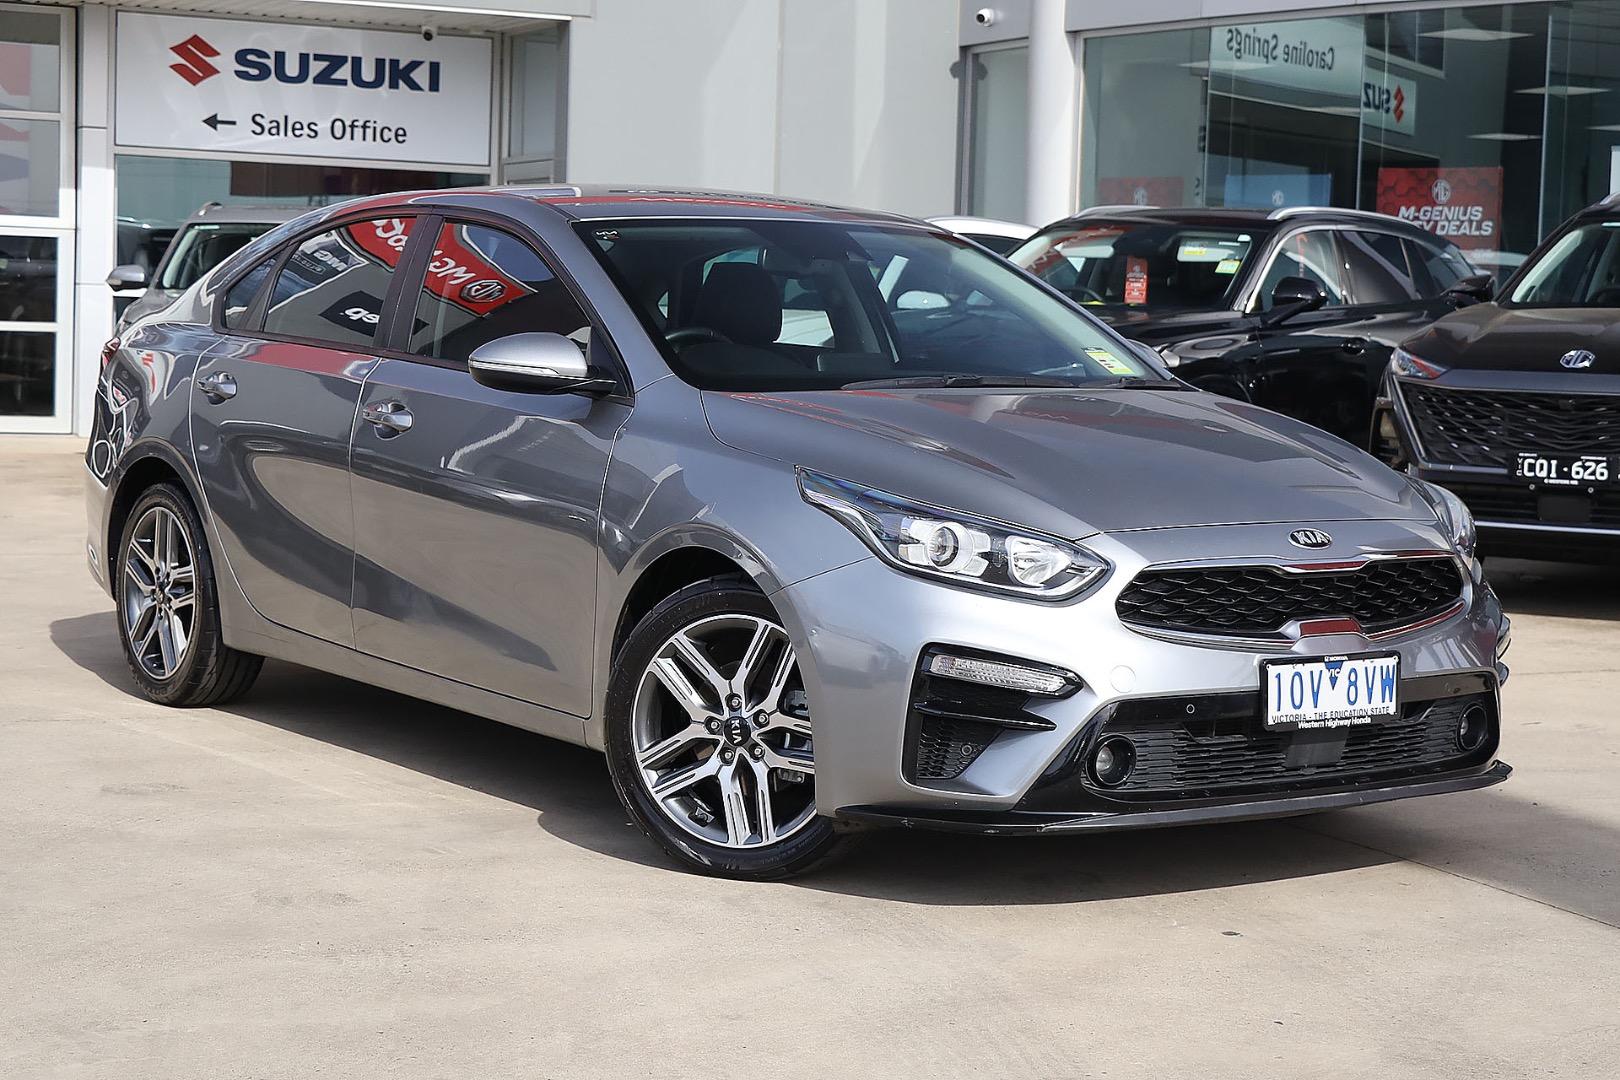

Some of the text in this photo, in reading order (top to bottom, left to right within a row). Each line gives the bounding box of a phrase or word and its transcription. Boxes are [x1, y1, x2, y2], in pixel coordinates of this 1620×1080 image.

[233, 47, 440, 93] SUZUKI
[250, 114, 408, 144] Sales Office
[1433, 180, 1450, 204] MG
[1398, 206, 1482, 221] M-GENIUS
[1435, 221, 1493, 236] DEALS
[1292, 531, 1329, 544] KIA
[1347, 664, 1396, 706] 8VW
[1272, 713, 1306, 723] VICTORIA
[1314, 712, 1327, 720] THE
[1330, 708, 1369, 718] EDUCATION
[1370, 706, 1390, 715] STATE
[1298, 716, 1371, 729] Western Highway Honda
[730, 718, 742, 744] KIA
